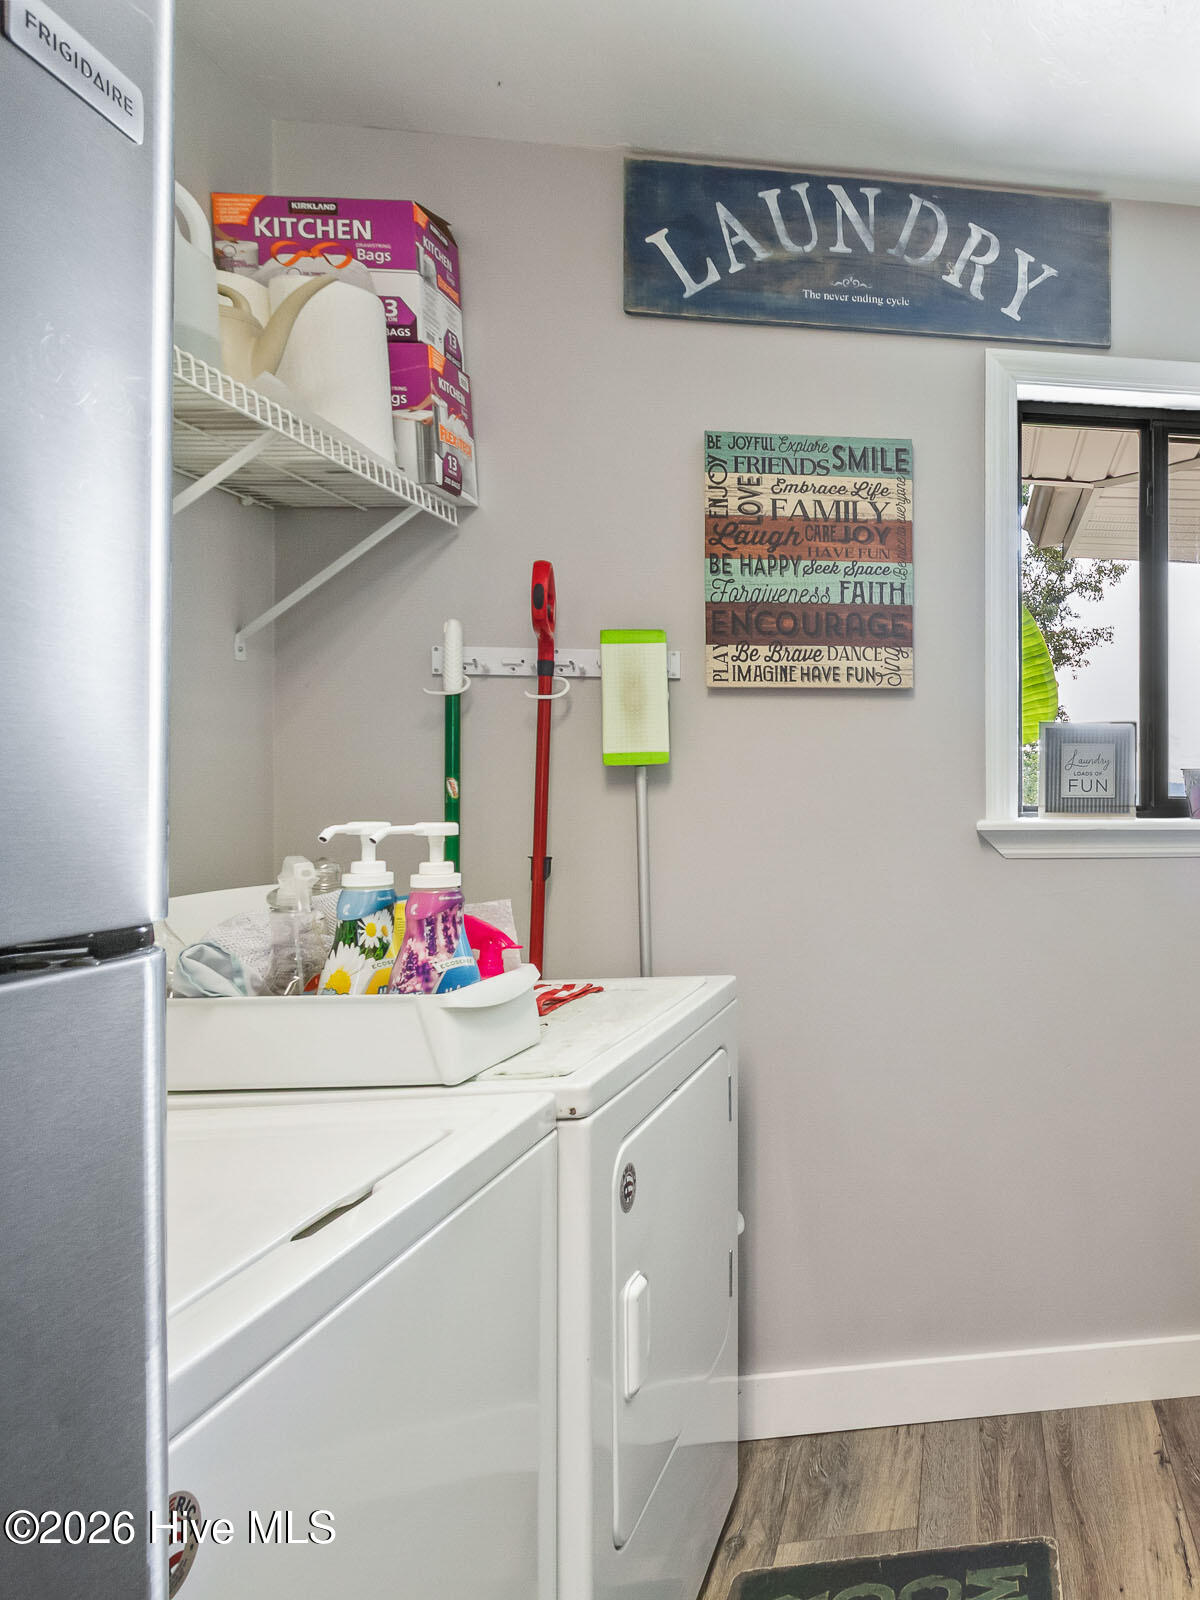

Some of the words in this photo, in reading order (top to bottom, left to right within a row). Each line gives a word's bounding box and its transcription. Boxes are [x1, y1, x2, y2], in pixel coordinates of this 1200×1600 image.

[25, 9, 133, 117] FRIGIDAIRE
[291, 202, 336, 211] KIRKLAND
[253, 216, 372, 240] KITCHEN
[356, 248, 391, 264] Bags
[423, 235, 453, 272] KITCHEN
[645, 181, 1058, 321] LAUNDRY
[384, 299, 398, 317] 3
[802, 289, 821, 299] The
[823, 293, 849, 302] never
[851, 294, 884, 305] ending
[886, 296, 910, 307] cycle
[438, 377, 466, 407] KITCHEN
[707, 435, 721, 449] BE
[728, 436, 776, 451] JOYFUL
[778, 436, 830, 456] Explore
[448, 455, 457, 472] 13
[733, 455, 831, 476] FRIENDS
[832, 445, 911, 474] SMILE
[707, 453, 729, 519] ENJOY
[771, 478, 848, 495] Embrace
[851, 481, 891, 500] Life
[737, 475, 763, 526] LOVE
[770, 498, 891, 523] FAMILY
[708, 521, 804, 552] Laugh
[805, 525, 836, 542] CARE
[837, 526, 892, 546] JOY
[709, 553, 733, 576] BE
[740, 553, 802, 578] HAPPY
[802, 560, 840, 576] Seek
[843, 560, 892, 576] Space
[808, 547, 854, 559] HAVE
[859, 549, 890, 560] FUN
[710, 578, 831, 612] Forgiveness
[839, 581, 906, 605] FAITH
[711, 609, 907, 638] ENCOURAGE
[712, 643, 729, 683] PLAY
[731, 641, 761, 662] Be
[764, 641, 824, 662] Brave
[828, 646, 883, 661] DANCE
[732, 665, 797, 682] IMAGINE
[800, 666, 841, 682] HAVE
[846, 666, 876, 683] FUN
[1065, 749, 1110, 770] Laundry
[1069, 778, 1108, 792] FUN
